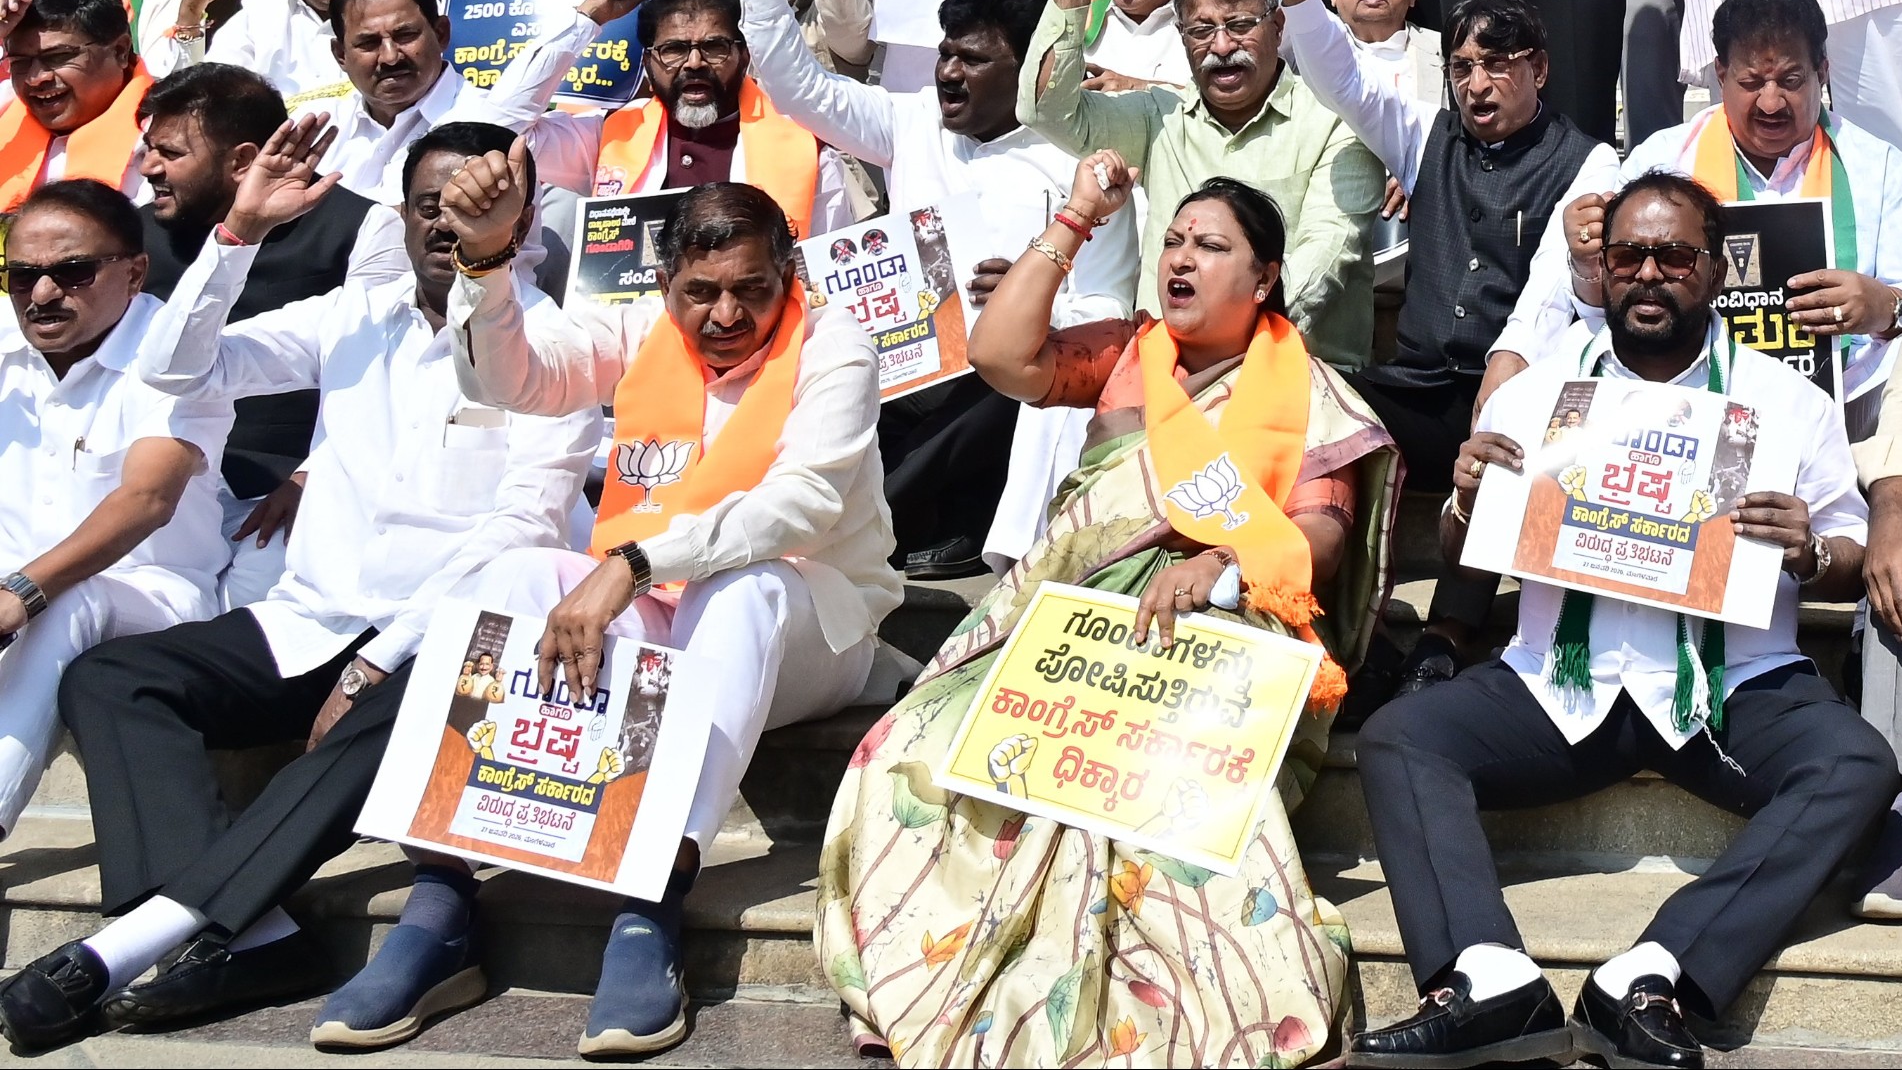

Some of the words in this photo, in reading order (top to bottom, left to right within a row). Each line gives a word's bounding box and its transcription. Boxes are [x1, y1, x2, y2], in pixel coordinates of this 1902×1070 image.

[463, 2, 505, 20] 2500
[825, 254, 907, 295] ಗೂಂಡಾ
[991, 687, 1118, 739] ಕಾಂಗ್ರೆಸ್
[477, 765, 536, 793] ಕಾಂಗ್ರೆಸ್
[533, 777, 596, 806] ಸರ್ಕಾರದ
